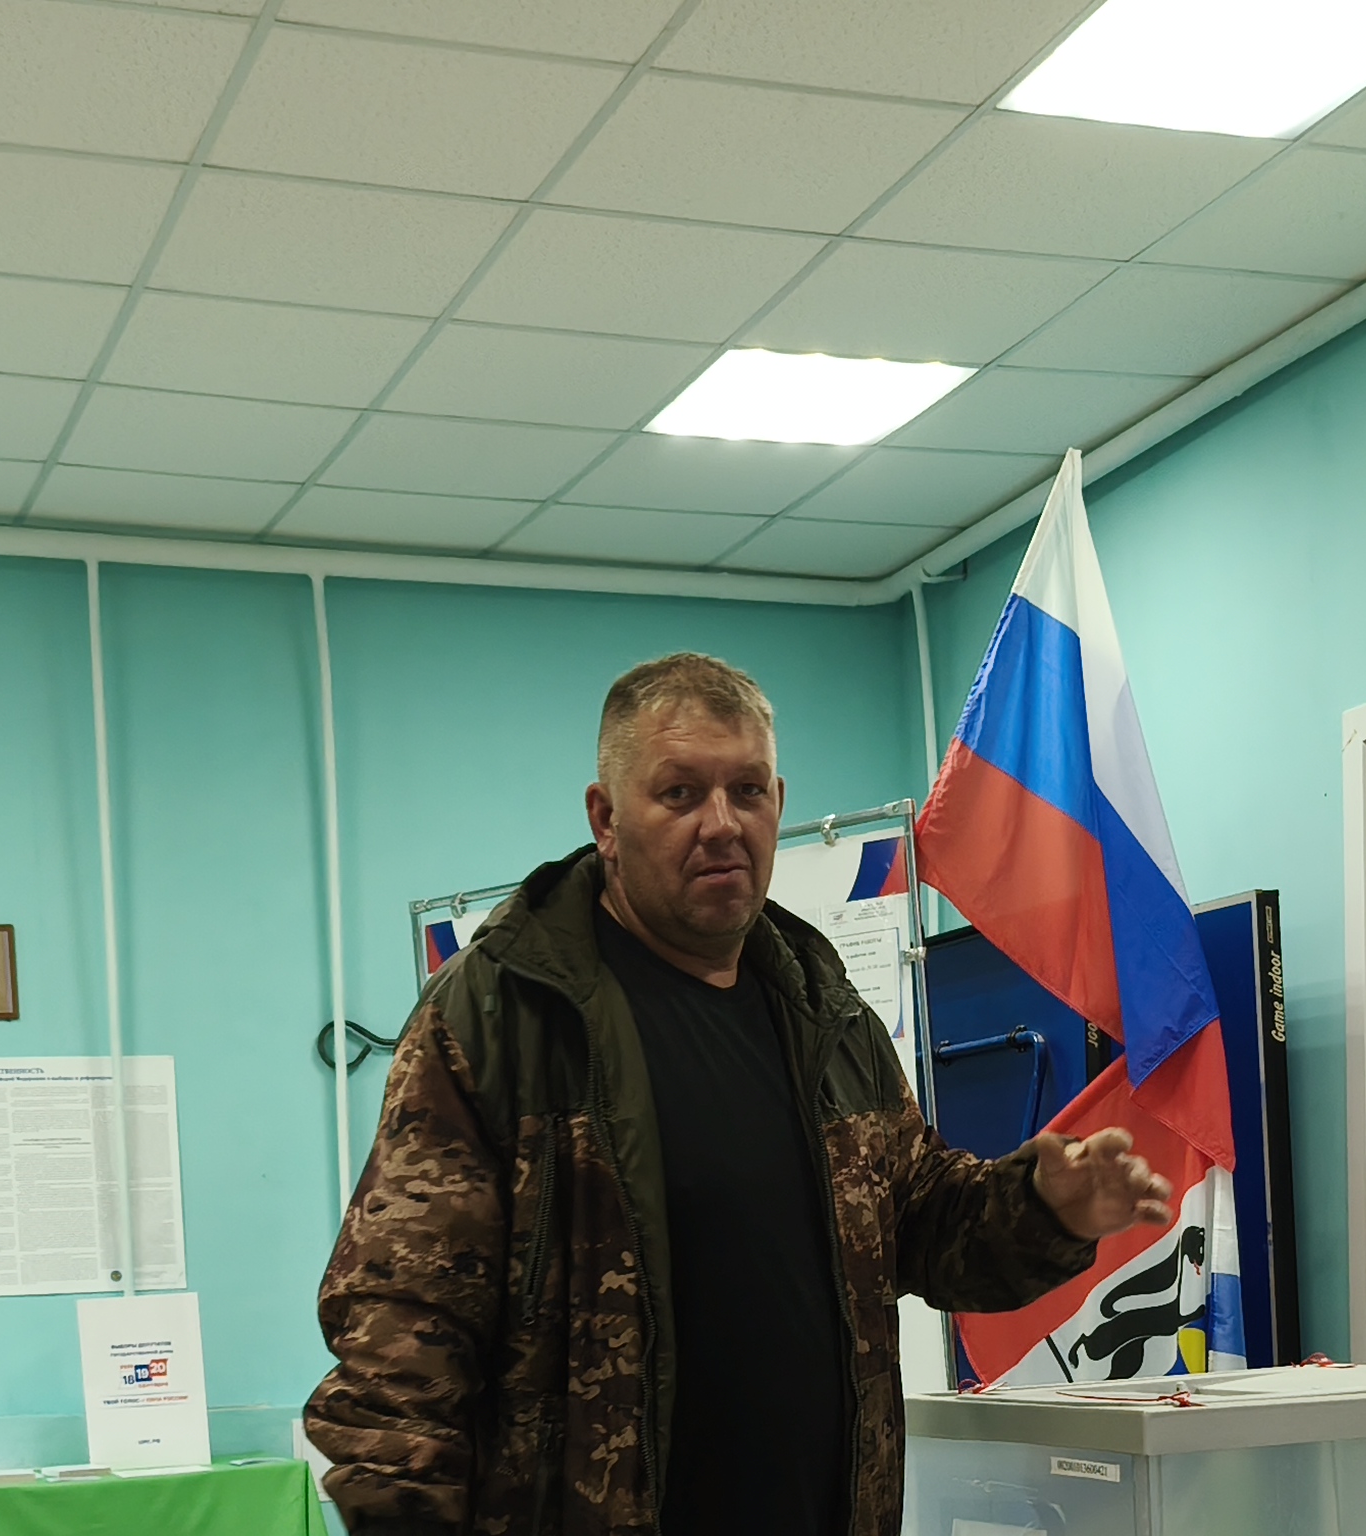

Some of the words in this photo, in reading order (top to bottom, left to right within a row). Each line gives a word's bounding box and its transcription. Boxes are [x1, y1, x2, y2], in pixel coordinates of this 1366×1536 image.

[1268, 951, 1283, 998] indoor
[1271, 1001, 1286, 1042] Game
[122, 1375, 135, 1385] 18
[136, 1368, 150, 1379] 19
[149, 1362, 166, 1374] 20
